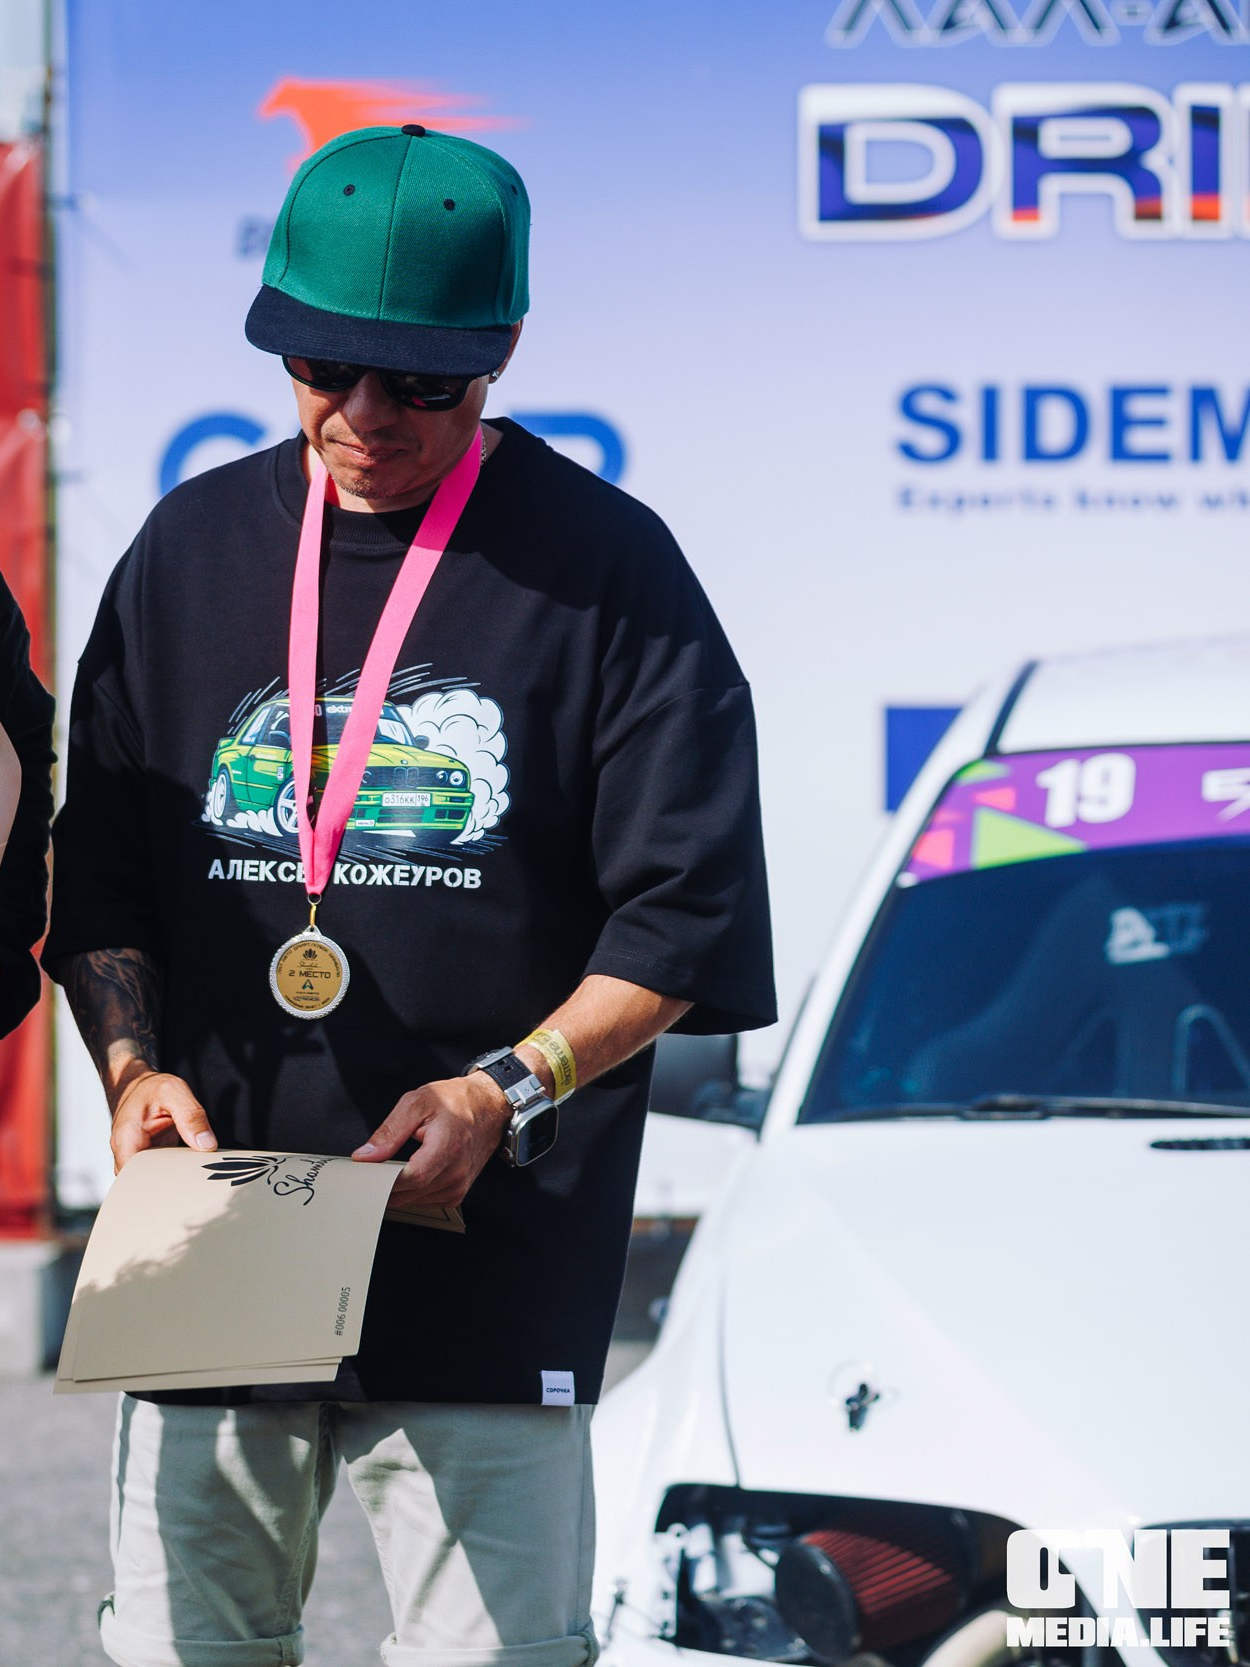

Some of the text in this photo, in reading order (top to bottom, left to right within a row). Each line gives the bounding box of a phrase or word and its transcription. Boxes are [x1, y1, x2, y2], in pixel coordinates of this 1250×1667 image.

[798, 82, 1250, 242] DRI
[1036, 752, 1137, 828] 19
[333, 863, 482, 889] КОЖЕУРОВ
[288, 969, 331, 979] 2 МЕСТО
[334, 1286, 351, 1336] #006 00005
